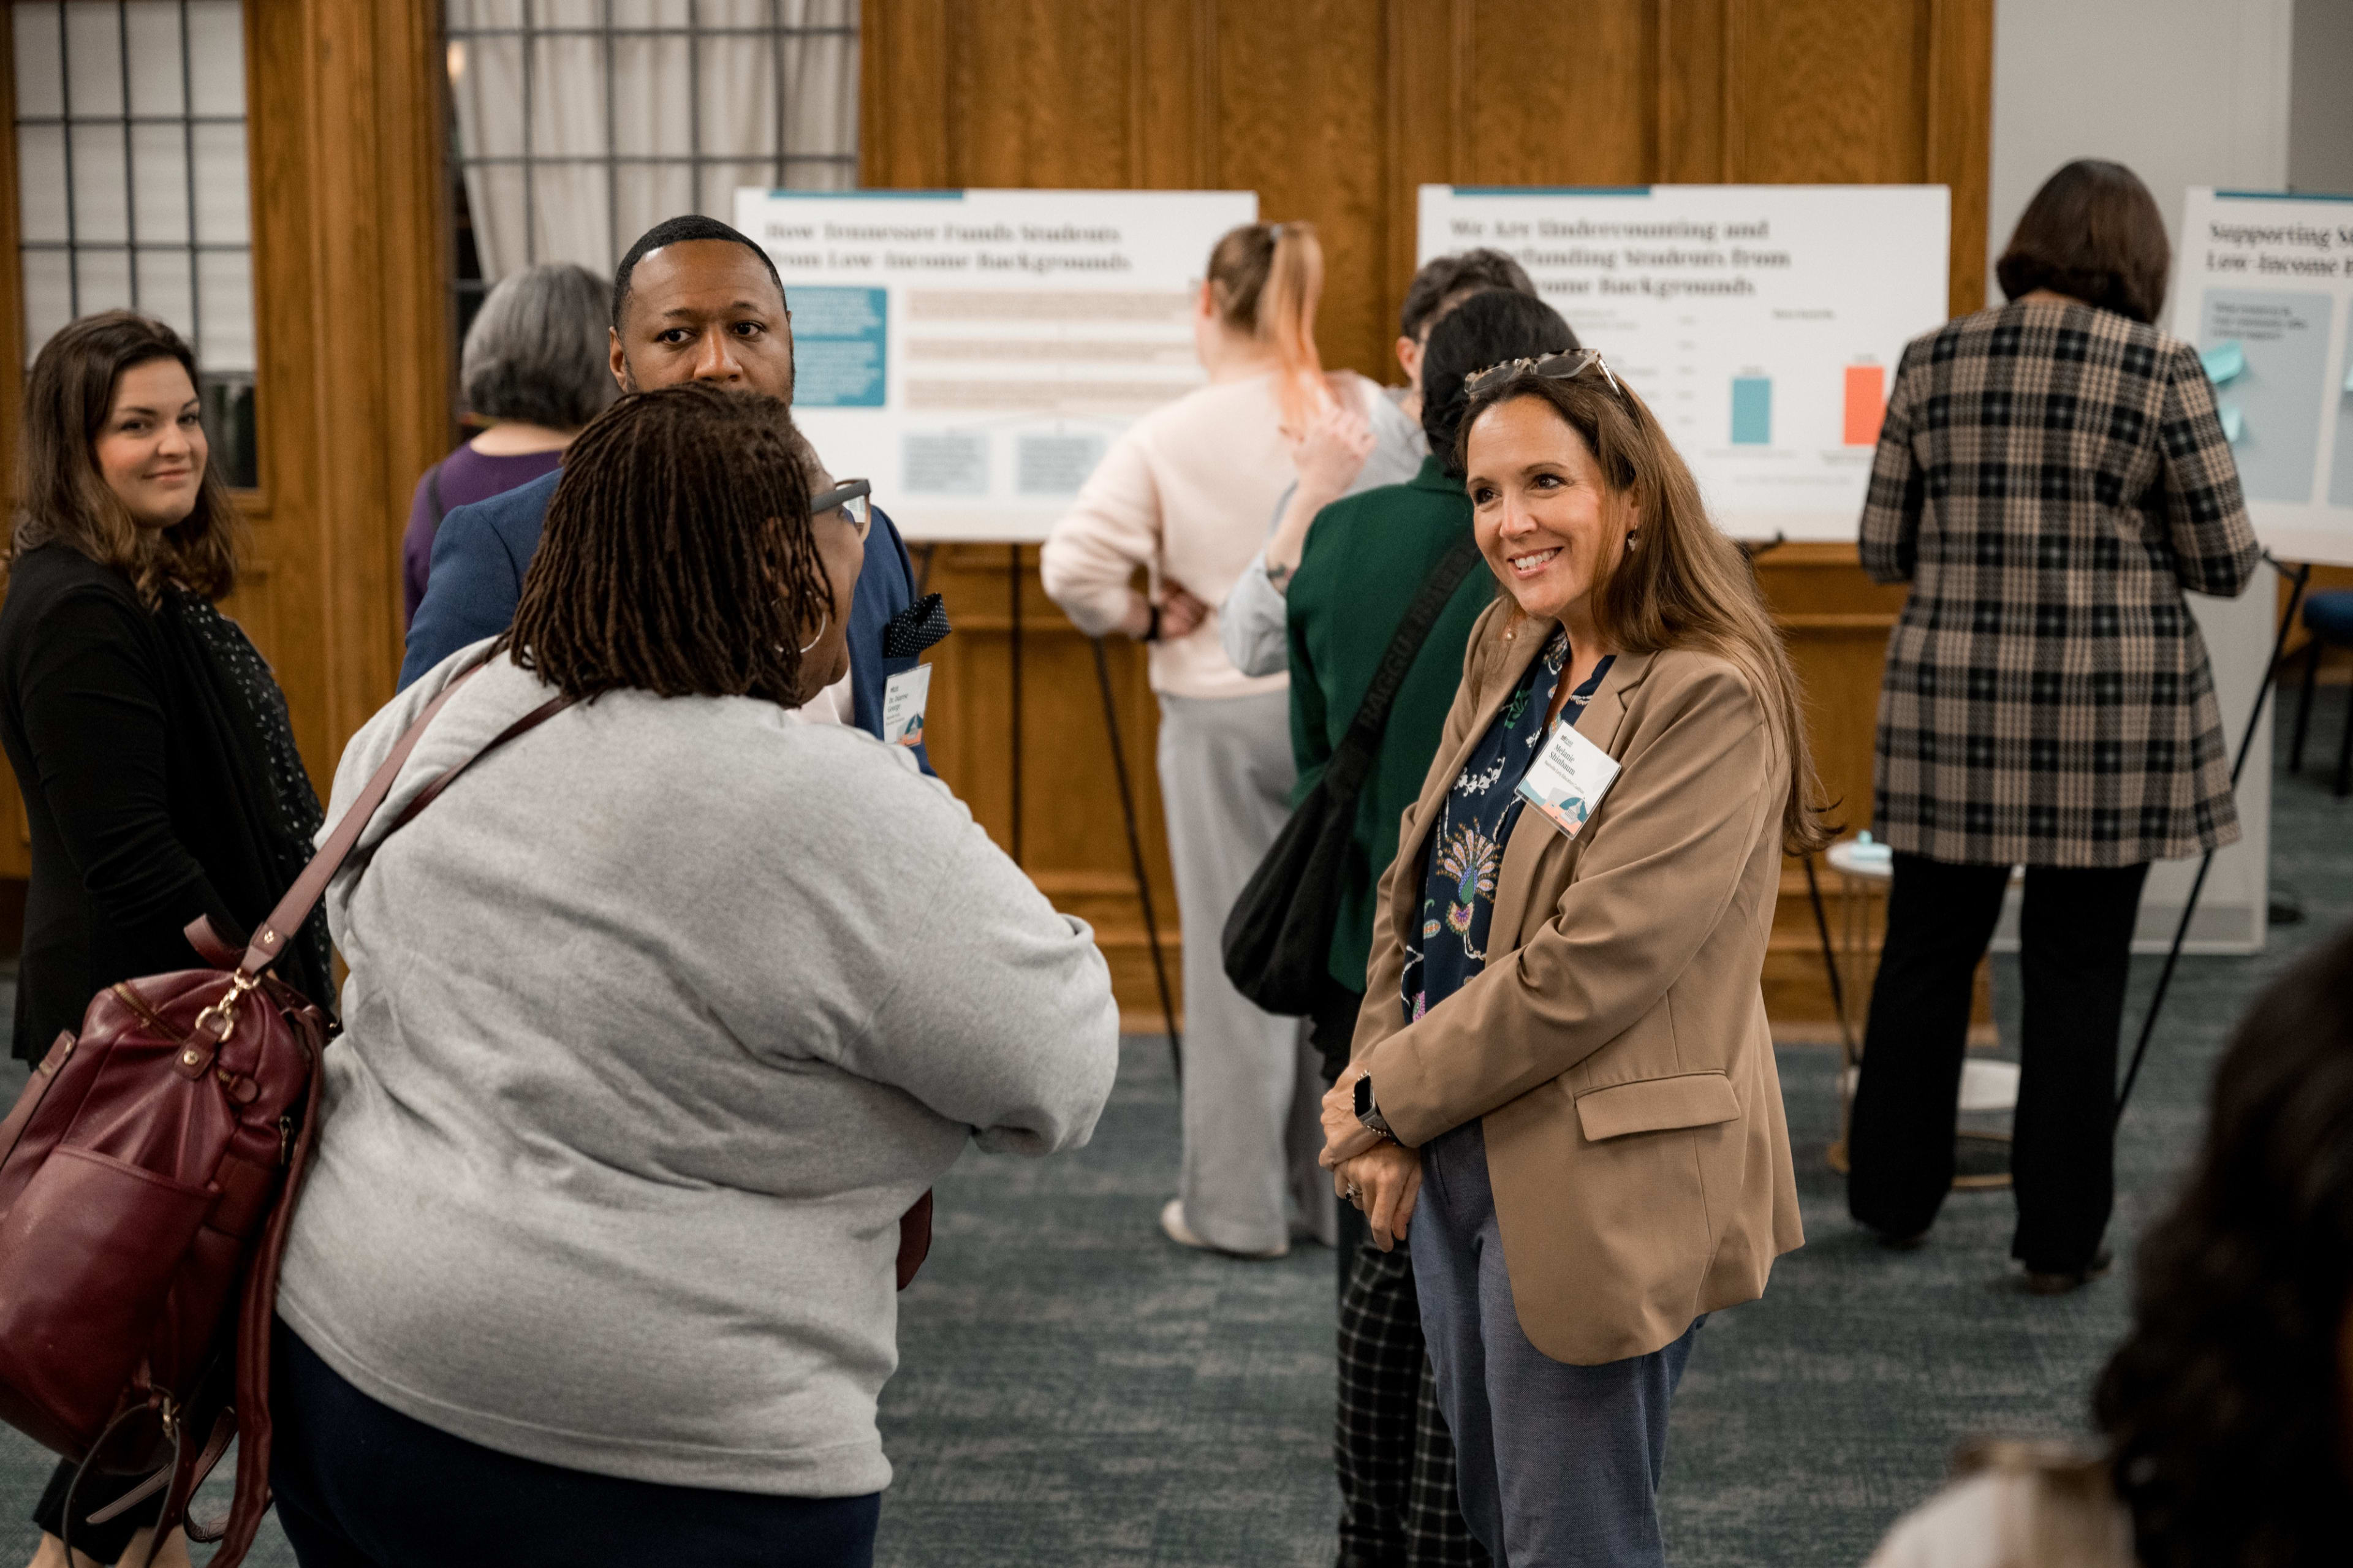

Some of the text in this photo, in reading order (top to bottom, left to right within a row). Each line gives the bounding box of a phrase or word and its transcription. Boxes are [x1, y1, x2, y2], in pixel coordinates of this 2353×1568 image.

[1018, 221, 1121, 240] Students
[1724, 220, 1770, 240] and
[2209, 222, 2331, 251] Supporting
[976, 249, 1134, 274] Backgrounds
[1625, 246, 1726, 267] Students
[1599, 276, 1754, 299] Backgrounds
[1549, 751, 1575, 776] Shinbaum
[1555, 744, 1575, 763] Melanie
